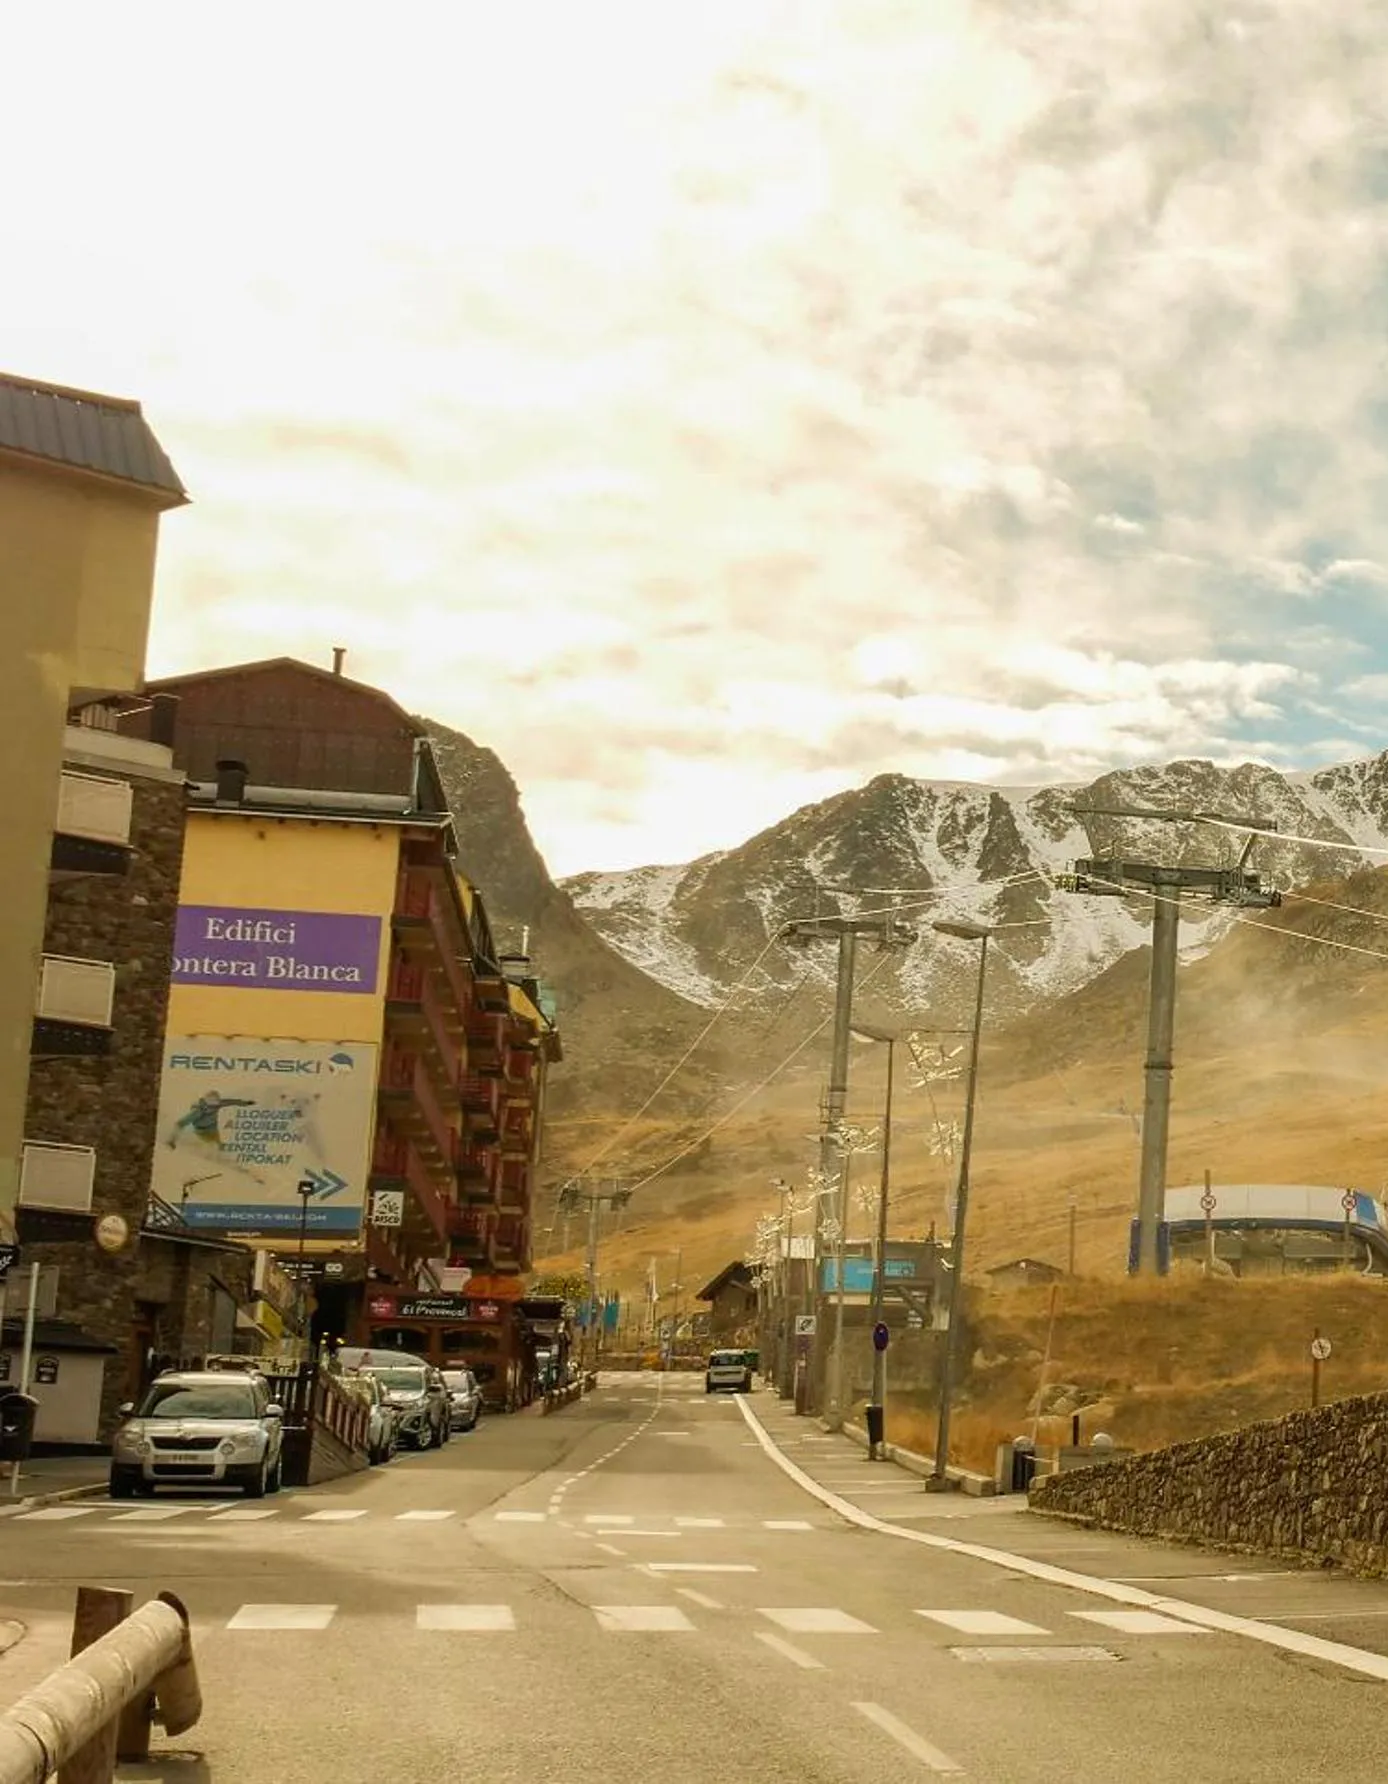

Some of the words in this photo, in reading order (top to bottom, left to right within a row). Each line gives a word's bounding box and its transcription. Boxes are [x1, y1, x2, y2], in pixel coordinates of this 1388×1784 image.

[204, 917, 297, 945] Edifici
[266, 956, 361, 982] Blanca
[170, 1055, 322, 1074] RENTASKI
[235, 1132, 305, 1142] LOCATION
